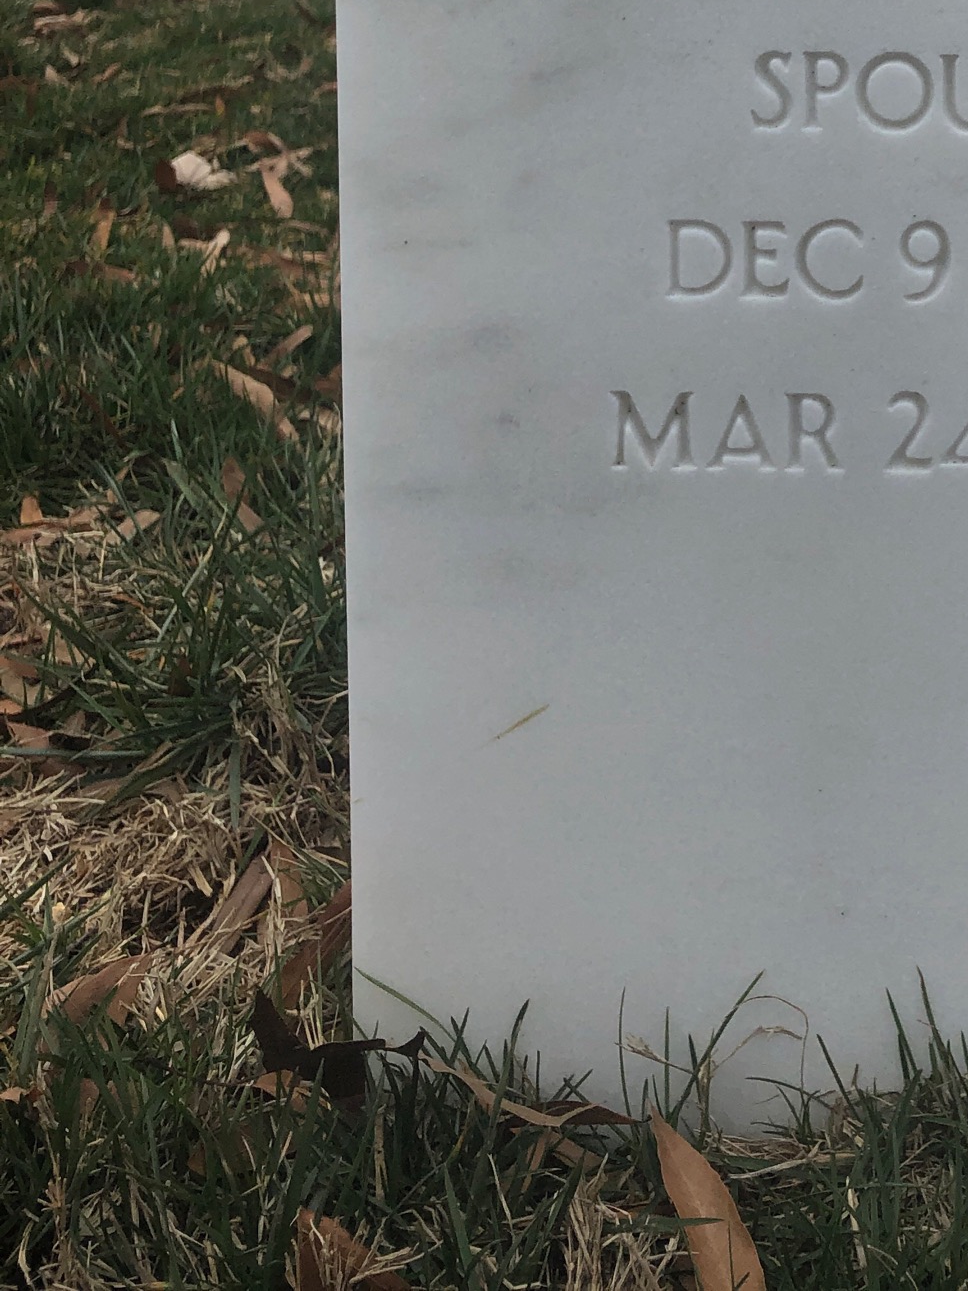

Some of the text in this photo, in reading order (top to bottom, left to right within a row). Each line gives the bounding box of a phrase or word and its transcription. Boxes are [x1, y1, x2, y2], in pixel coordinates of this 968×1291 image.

[665, 218, 864, 301] DEC
[901, 219, 952, 303] 9
[610, 390, 845, 472] MAR
